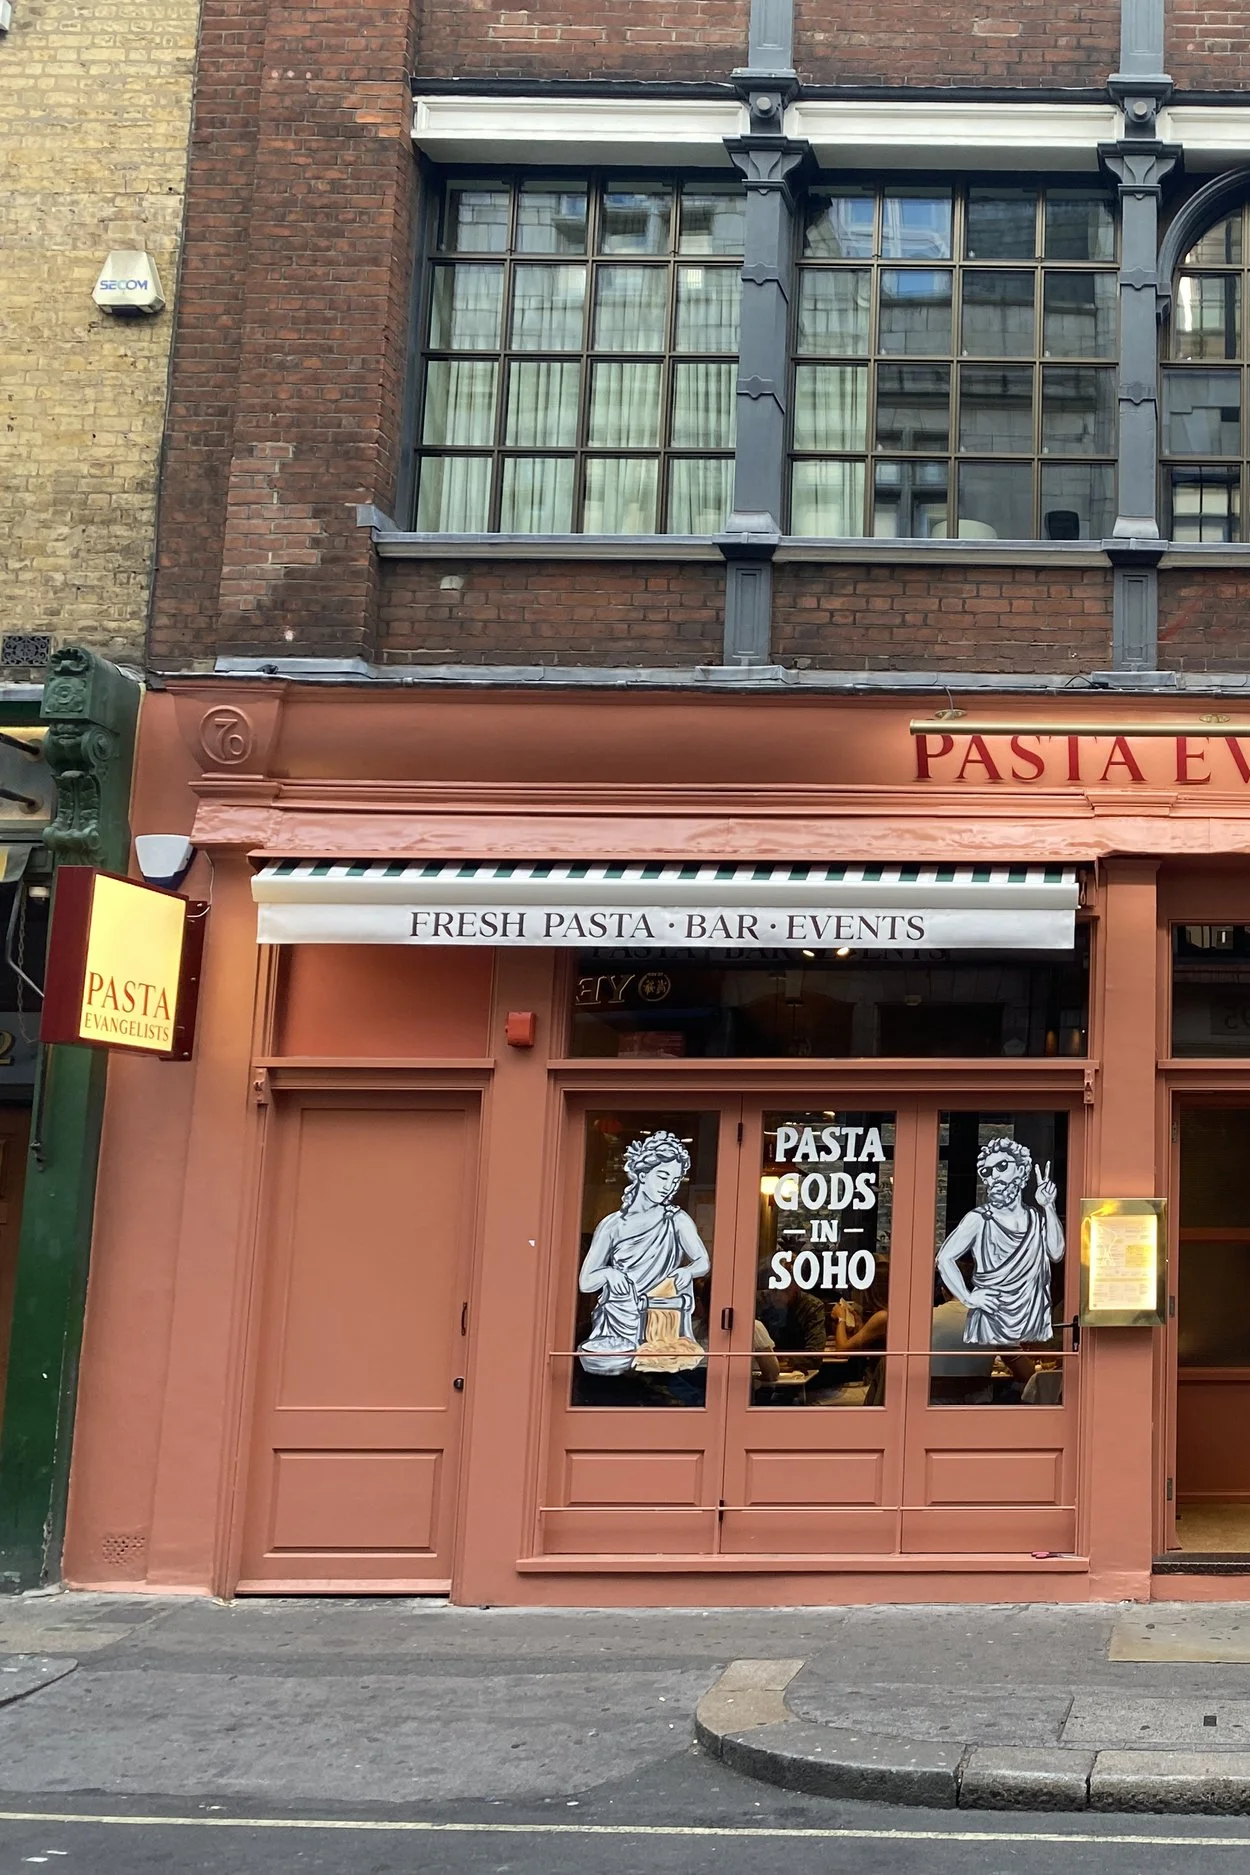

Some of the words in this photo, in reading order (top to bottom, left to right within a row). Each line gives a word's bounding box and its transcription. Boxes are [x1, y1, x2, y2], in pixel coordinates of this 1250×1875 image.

[99, 280, 148, 290] SECOM
[915, 734, 1147, 782] PASTA
[409, 911, 527, 938] FRESH
[543, 912, 656, 939] PASTA
[684, 913, 760, 941] BAR
[786, 914, 925, 941] EVENTS
[87, 971, 171, 1020] PASTA
[84, 1012, 170, 1042] EVANGELISTS
[775, 1126, 887, 1162] PASTA
[773, 1172, 877, 1211] GODS
[768, 1249, 876, 1290] SOHO
